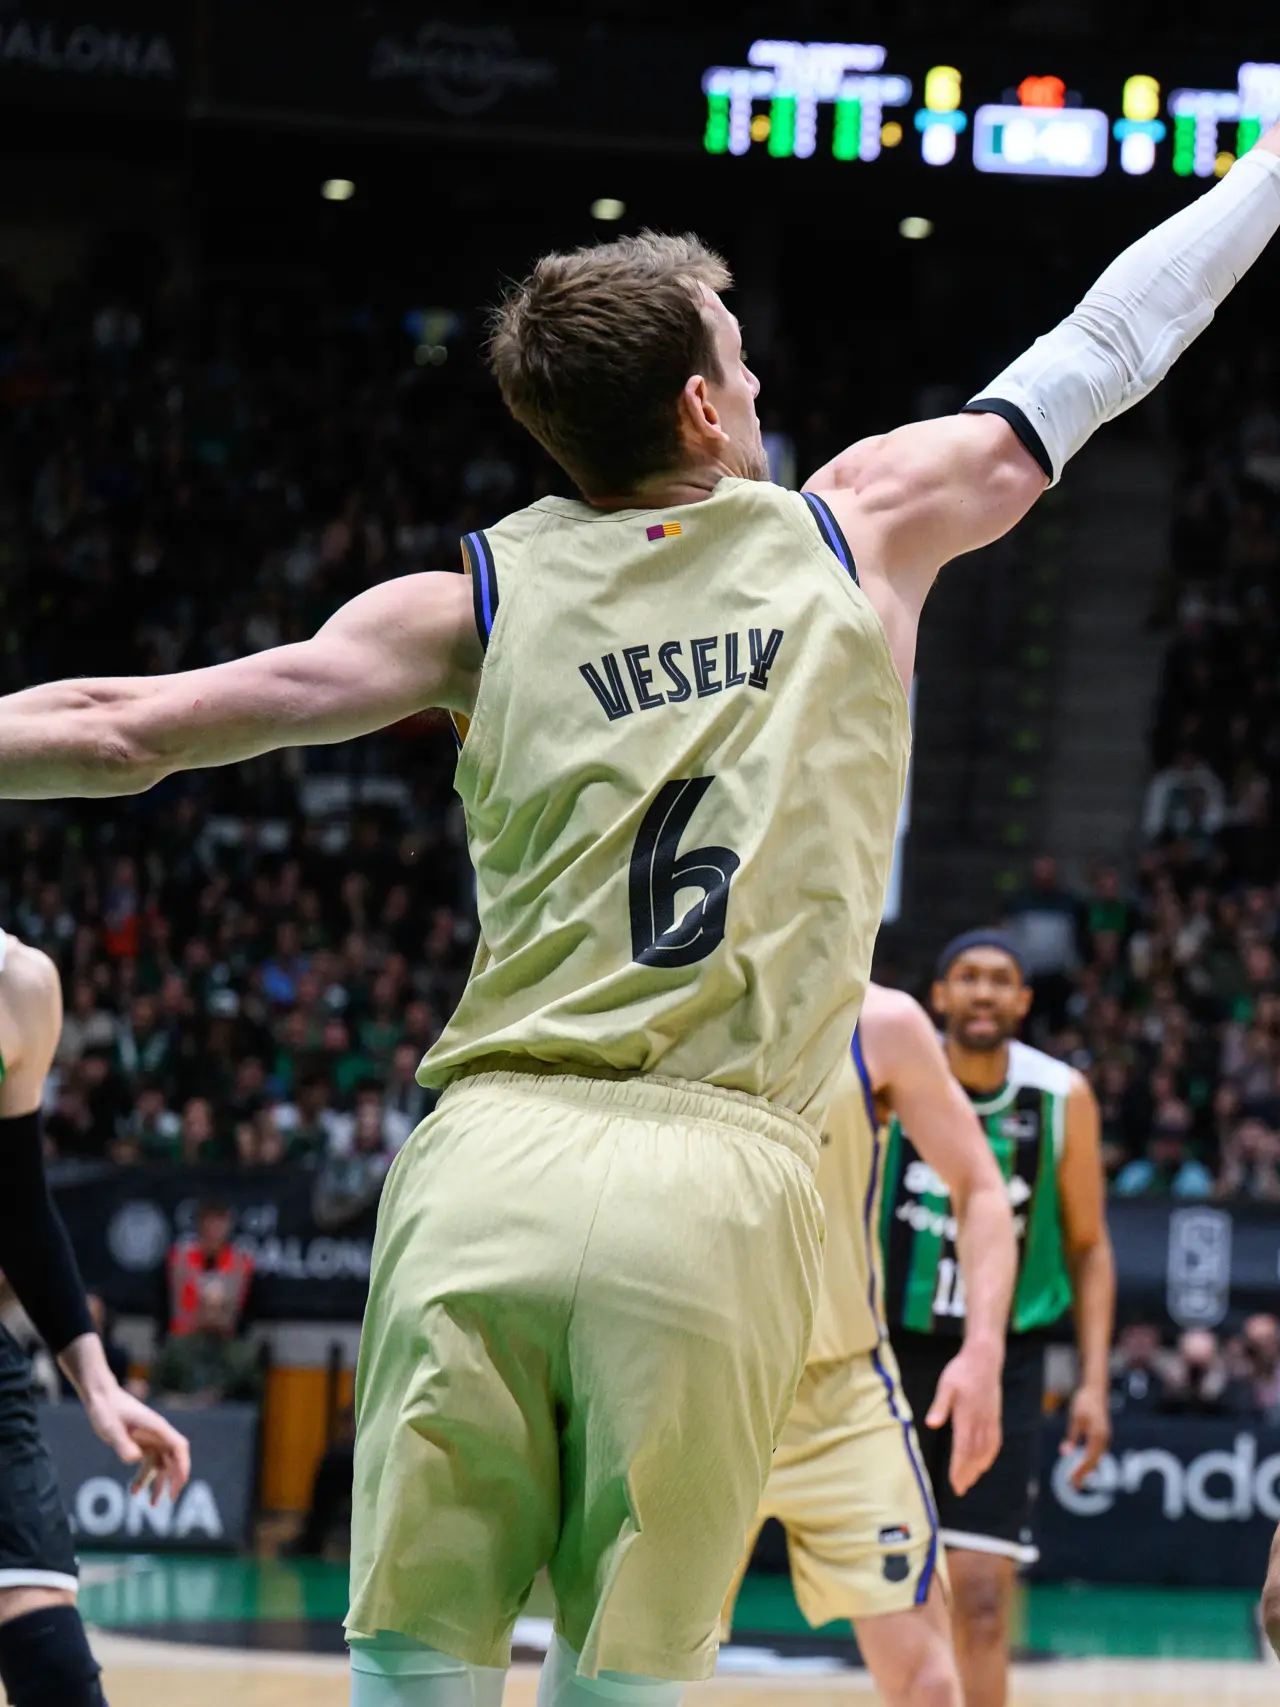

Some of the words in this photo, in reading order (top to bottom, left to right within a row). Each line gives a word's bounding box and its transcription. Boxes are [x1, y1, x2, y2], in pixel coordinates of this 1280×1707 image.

[578, 628, 784, 721] VESELY
[628, 775, 740, 968] 6
[68, 1475, 224, 1540] ONA
